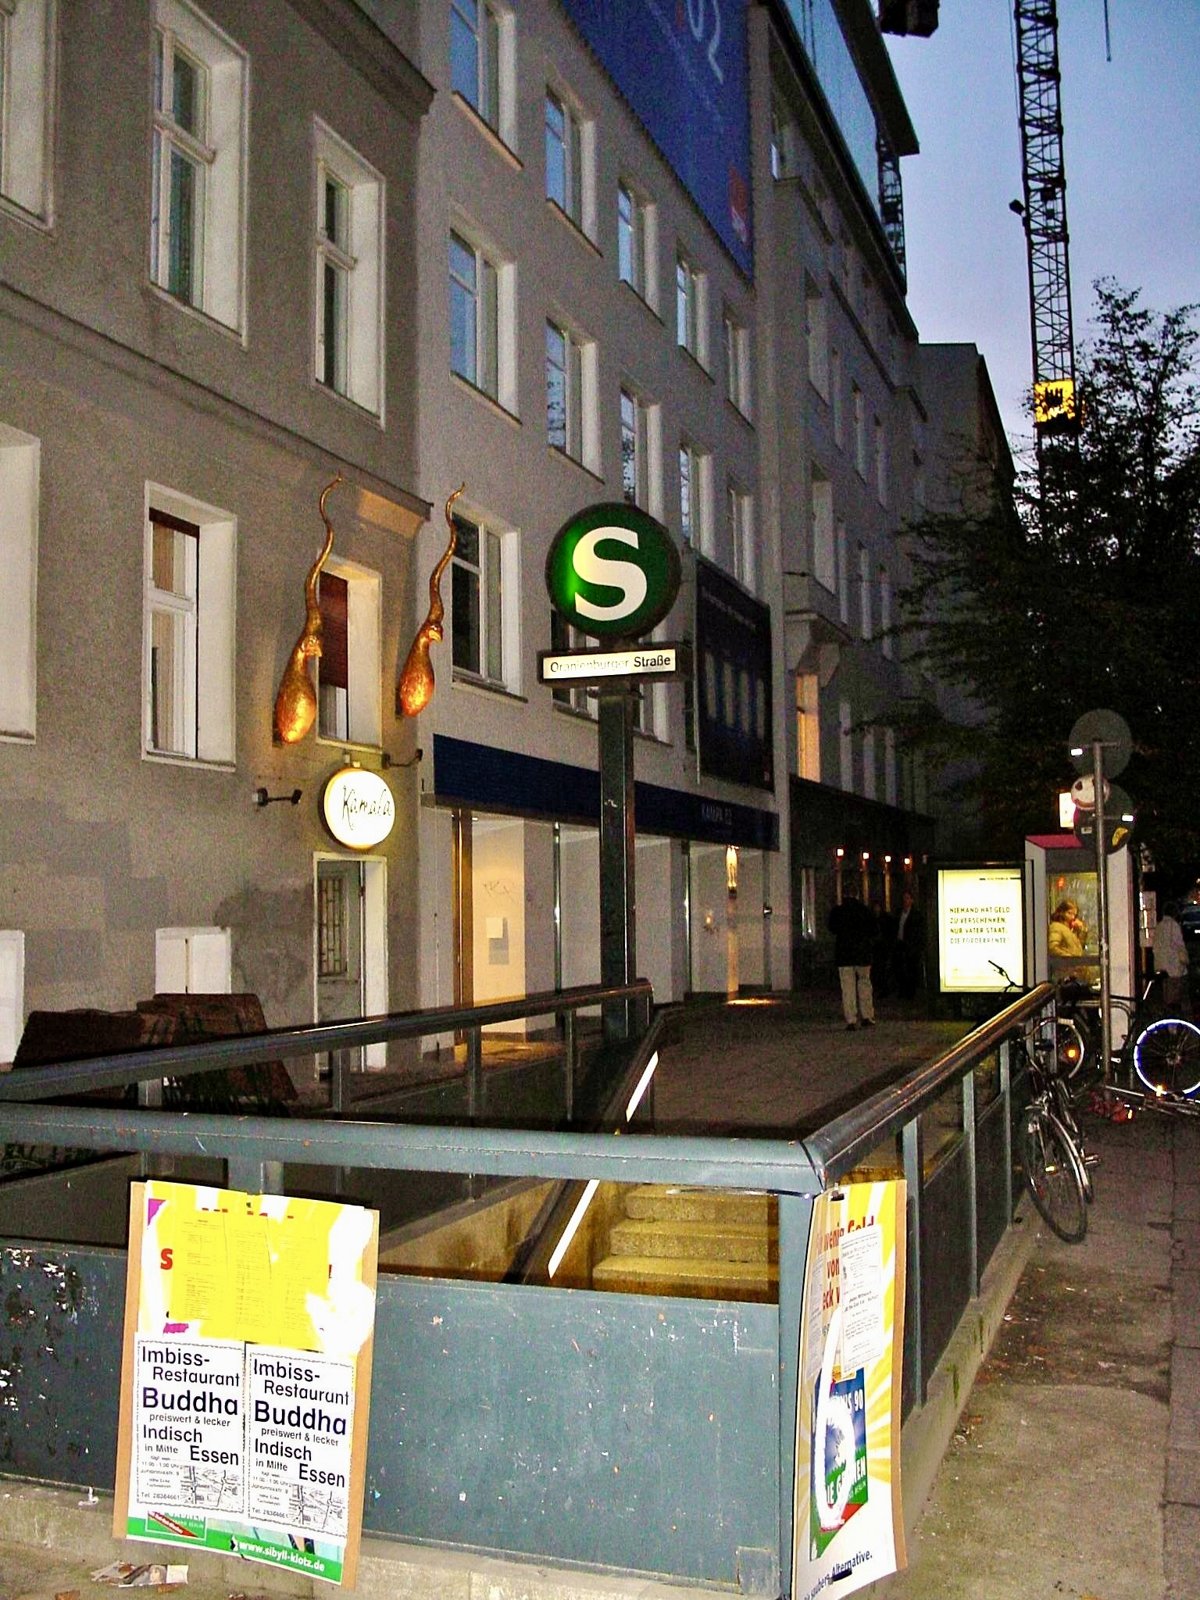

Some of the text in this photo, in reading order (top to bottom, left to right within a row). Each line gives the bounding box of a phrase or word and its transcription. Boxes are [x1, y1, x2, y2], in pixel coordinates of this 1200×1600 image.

[572, 526, 648, 621] S
[633, 654, 671, 668] Straße
[142, 1346, 210, 1366] Imbiss-
[152, 1366, 240, 1387] Restaurant
[253, 1358, 320, 1382] Imbiss-
[142, 1386, 238, 1415] Buddha
[264, 1379, 349, 1405] Restaurant
[149, 1413, 231, 1427] preiswert & lecker
[254, 1399, 347, 1435] Buddha
[143, 1424, 203, 1443] Indisch
[261, 1427, 339, 1447] preiswert & lecker
[144, 1443, 179, 1454] in Mitte
[189, 1445, 239, 1466] Essen
[254, 1438, 312, 1461] Indisch
[255, 1458, 288, 1471] in Mitte
[298, 1462, 345, 1488] Essen
[238, 1541, 325, 1572] www.sibyll-klotz.de
